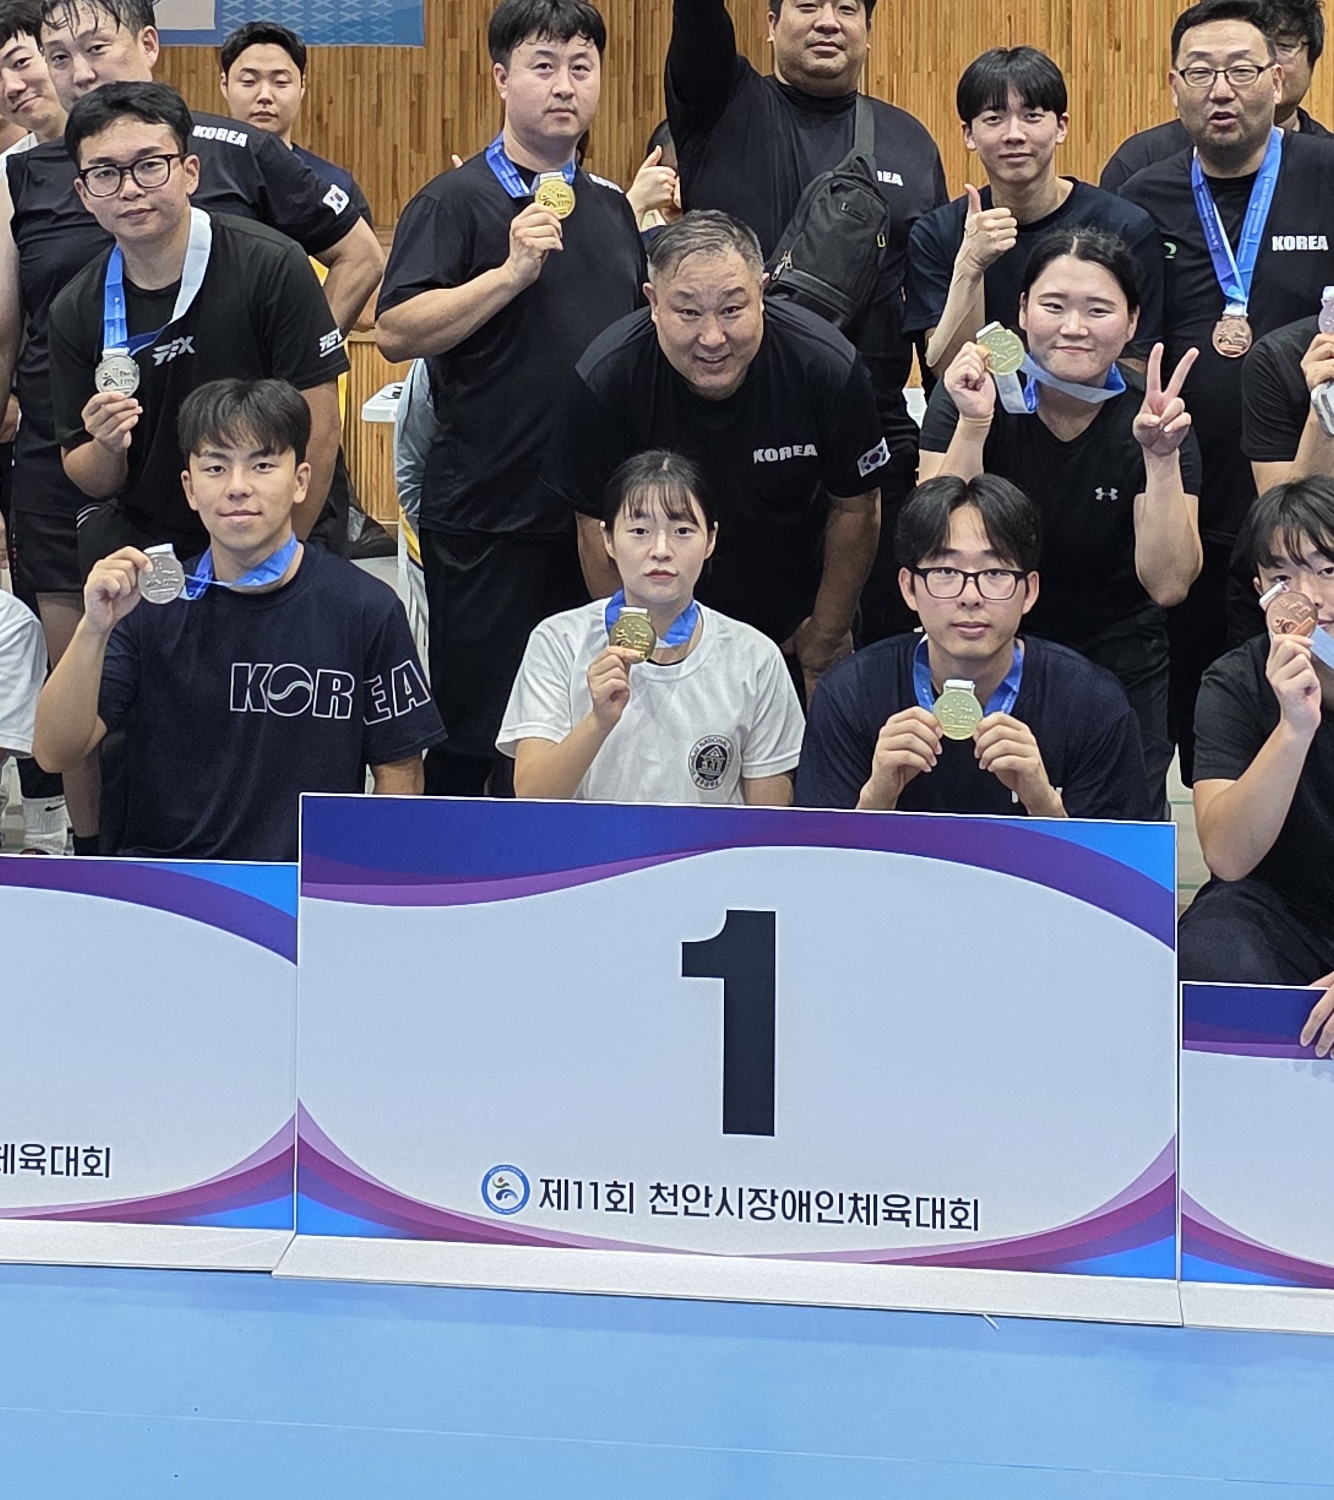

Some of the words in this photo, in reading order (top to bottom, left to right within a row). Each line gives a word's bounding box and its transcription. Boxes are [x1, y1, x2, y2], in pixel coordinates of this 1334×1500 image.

[192, 124, 248, 148] KOREA
[1271, 234, 1329, 251] KOREA
[753, 443, 818, 465] KOREA
[229, 659, 432, 726] KOREA
[680, 908, 777, 1138] 1
[538, 1177, 635, 1215] 제11회
[648, 1181, 980, 1232] 천안시장애인체육대회
